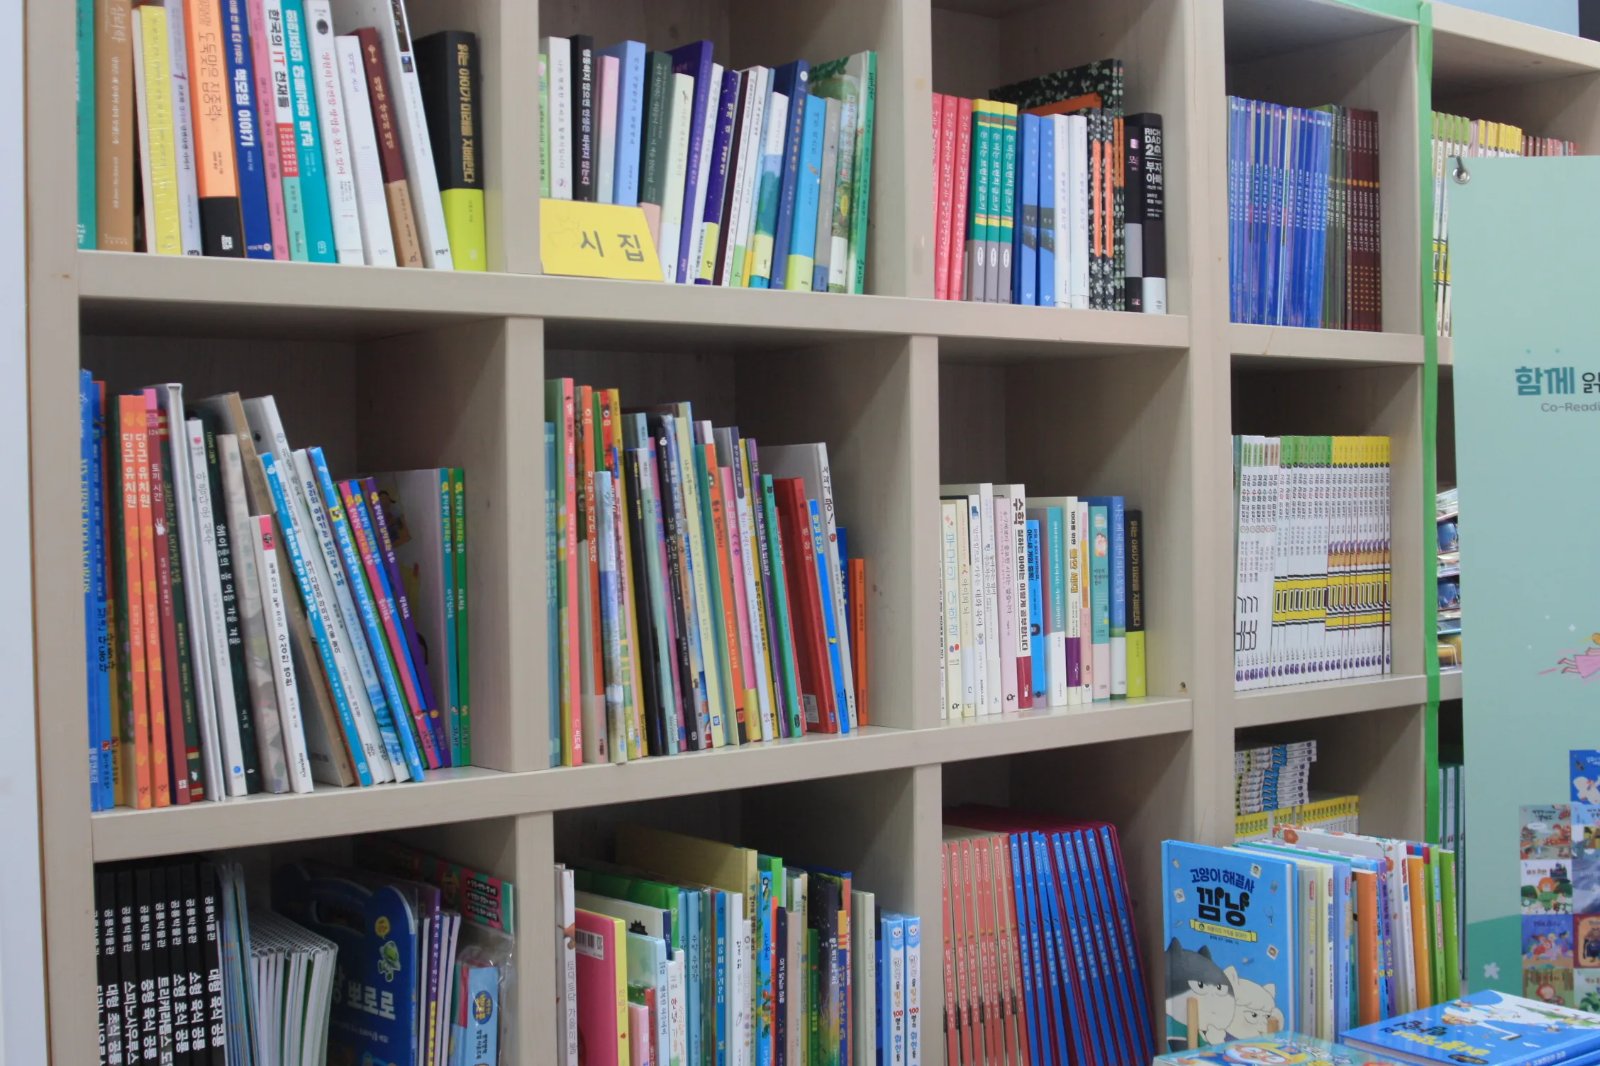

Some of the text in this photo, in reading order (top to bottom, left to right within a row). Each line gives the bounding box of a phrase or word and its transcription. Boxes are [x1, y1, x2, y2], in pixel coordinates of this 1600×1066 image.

[268, 9, 290, 108] 한국의 IT 천재들
[199, 32, 223, 118] 도둑맞은 집중력
[234, 68, 250, 106] 책모임
[237, 109, 255, 146] 이야기
[457, 43, 474, 183] 읽는 아이가 미래를 지배한다
[580, 49, 591, 185] 행동하지 않으면 인생은 바뀌지 않는다
[980, 131, 988, 139] 돈
[993, 133, 1001, 141] 돈
[1006, 134, 1014, 142] 돈
[1144, 127, 1161, 137] RICH
[1144, 135, 1161, 145] DAD
[979, 141, 988, 157] 버는
[992, 143, 1001, 159] 버는
[1006, 144, 1014, 160] 버는
[1145, 161, 1162, 173] 부자
[1146, 172, 1162, 185] 아빠
[978, 185, 987, 210] 글쓰기
[991, 186, 1000, 212] 글쓰기
[1004, 188, 1014, 213] 글쓰기
[581, 230, 645, 262] 시 집
[1515, 366, 1575, 395] 함께
[1013, 498, 1025, 526] 수학
[1017, 529, 1025, 554] 잘하는
[1130, 539, 1139, 565] 아이가
[221, 572, 232, 580] 봄
[1018, 555, 1026, 581] 아이는
[1131, 566, 1139, 592] 미래를
[223, 584, 238, 602] 여름
[227, 606, 240, 622] 가을
[1132, 593, 1141, 627] 지배한다
[229, 627, 241, 645] 겨울
[1020, 609, 1028, 651] 공부합니다
[1189, 867, 1255, 894] 고양이 해결사
[186, 898, 197, 944] 공룡박물관
[204, 895, 217, 942] 공룡박물관
[1196, 886, 1250, 927] 깜냥
[104, 907, 115, 955] 공룡박물관
[121, 906, 132, 952] 공룡박물관
[140, 904, 151, 951] 공룡박물관
[155, 902, 167, 948] 공룡박물관
[170, 899, 182, 946] 공룡박물관
[124, 980, 140, 1065] 스피노사우루스
[141, 978, 158, 1060] 중형 육식 공룡
[157, 975, 173, 1049] 트리케라톱스
[173, 973, 190, 1054] 소형 초식 공룡
[189, 971, 206, 1051] 소형 육식 공룡
[208, 968, 225, 1047] 대형 육식 공룡
[106, 983, 122, 1065] 대형 초식 공룡
